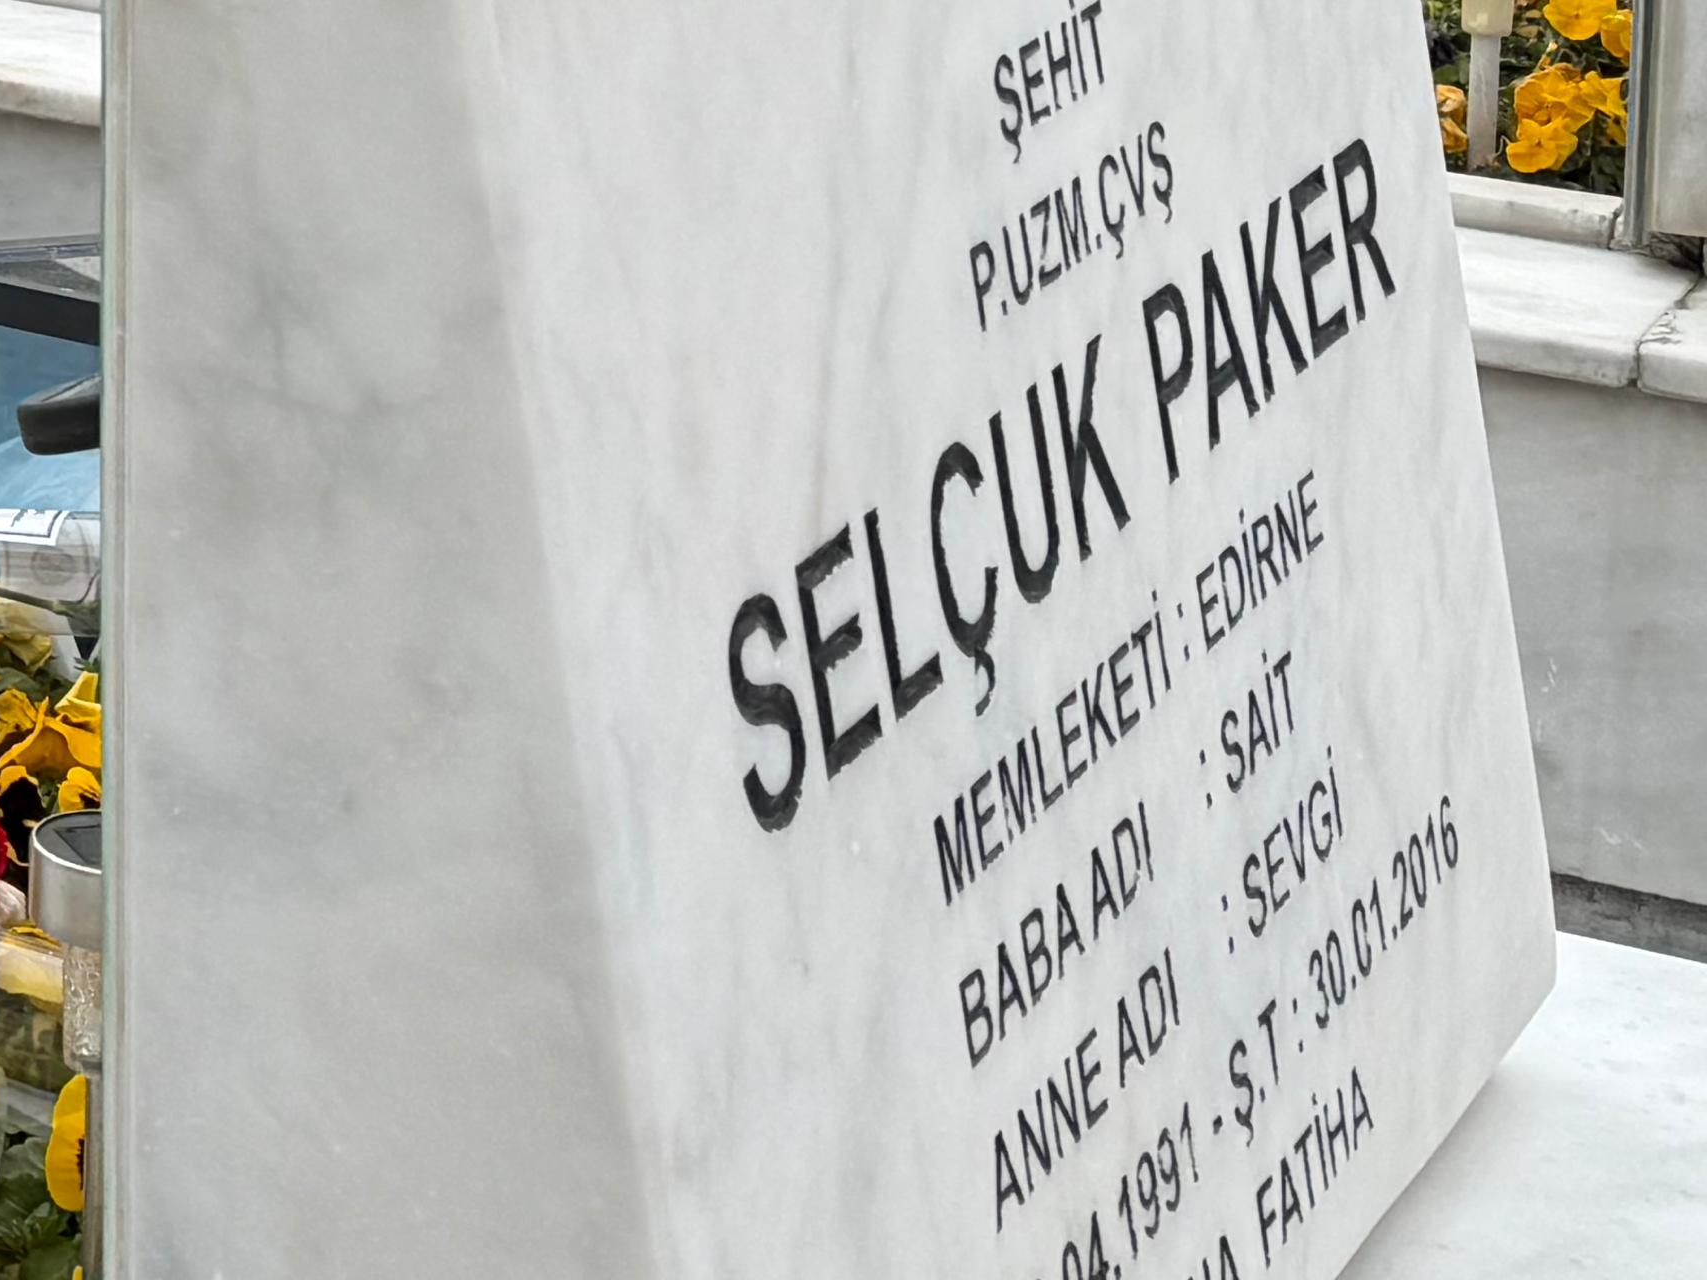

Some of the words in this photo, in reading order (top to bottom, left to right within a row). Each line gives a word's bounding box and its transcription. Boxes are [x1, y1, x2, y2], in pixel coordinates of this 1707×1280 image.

[970, 120, 1173, 332] P.UZM.ÇVŞ
[728, 334, 1131, 833] SELÇUK
[1142, 138, 1396, 485] PAKER
[932, 589, 1172, 907] MEMLEKETİ
[1195, 469, 1325, 654] EDİRNE
[958, 882, 1086, 1069] BABA
[1090, 800, 1155, 940] ADI
[1220, 650, 1296, 794] SAİT
[994, 1028, 1109, 1234] ANNE
[1116, 947, 1180, 1089] ADI
[1242, 745, 1344, 938] SEVGİ
[1308, 795, 1459, 1030] 30.01.2016
[1255, 1065, 1373, 1269] FATİHA
